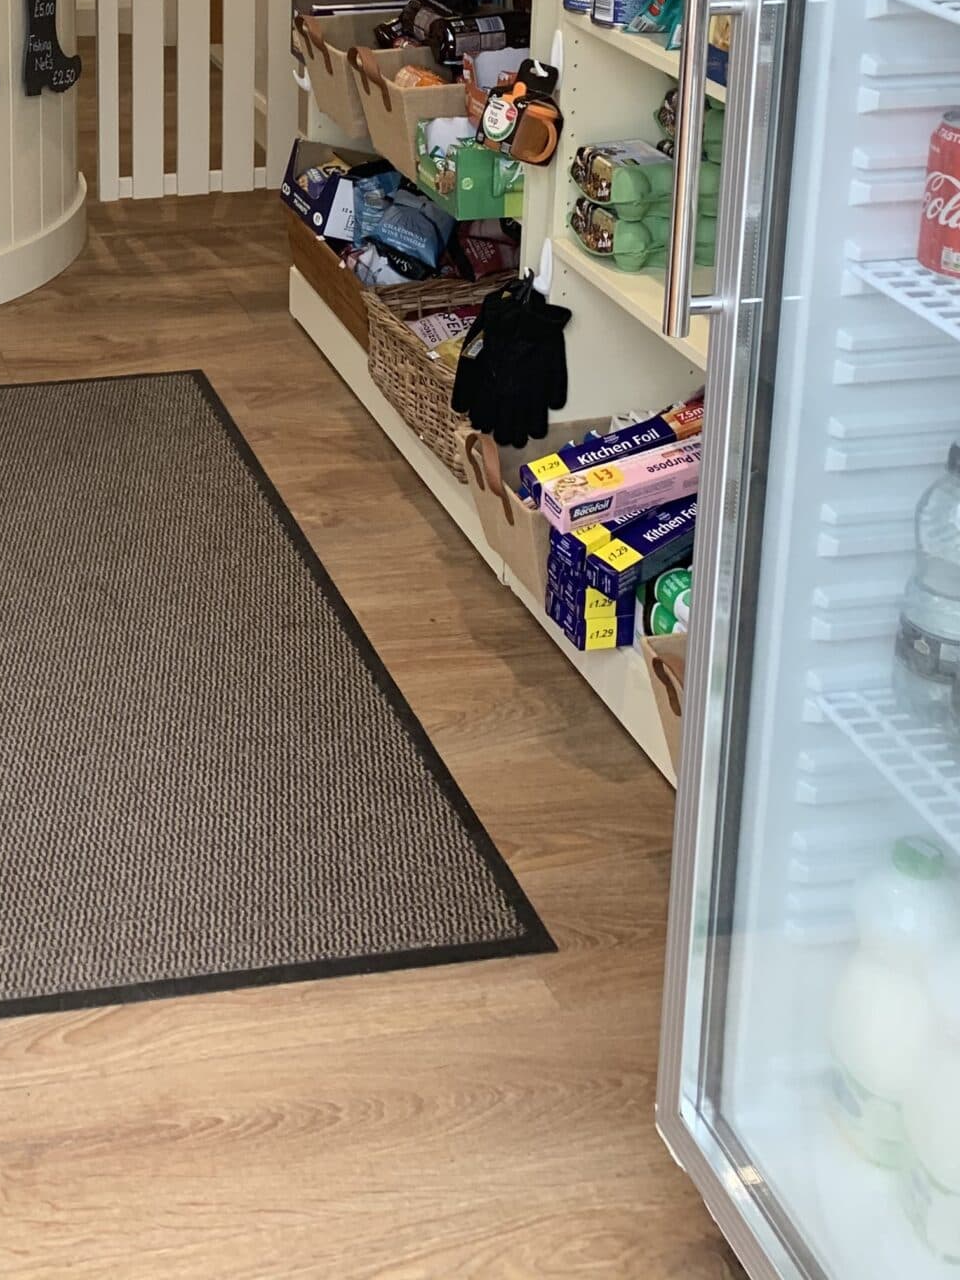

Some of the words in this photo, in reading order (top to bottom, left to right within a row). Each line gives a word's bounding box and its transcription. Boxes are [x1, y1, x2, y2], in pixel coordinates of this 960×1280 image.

[34, 57, 54, 71] Nets
[577, 440, 632, 466] Kitchen
[634, 428, 661, 447] Foil
[537, 460, 560, 474] £1.29
[647, 454, 696, 473] Purpose
[593, 468, 614, 482] £1
[573, 500, 611, 518] Bacofoil
[642, 515, 683, 543] Kitchen
[607, 545, 629, 562] £1.29
[590, 628, 614, 640] £1.29
